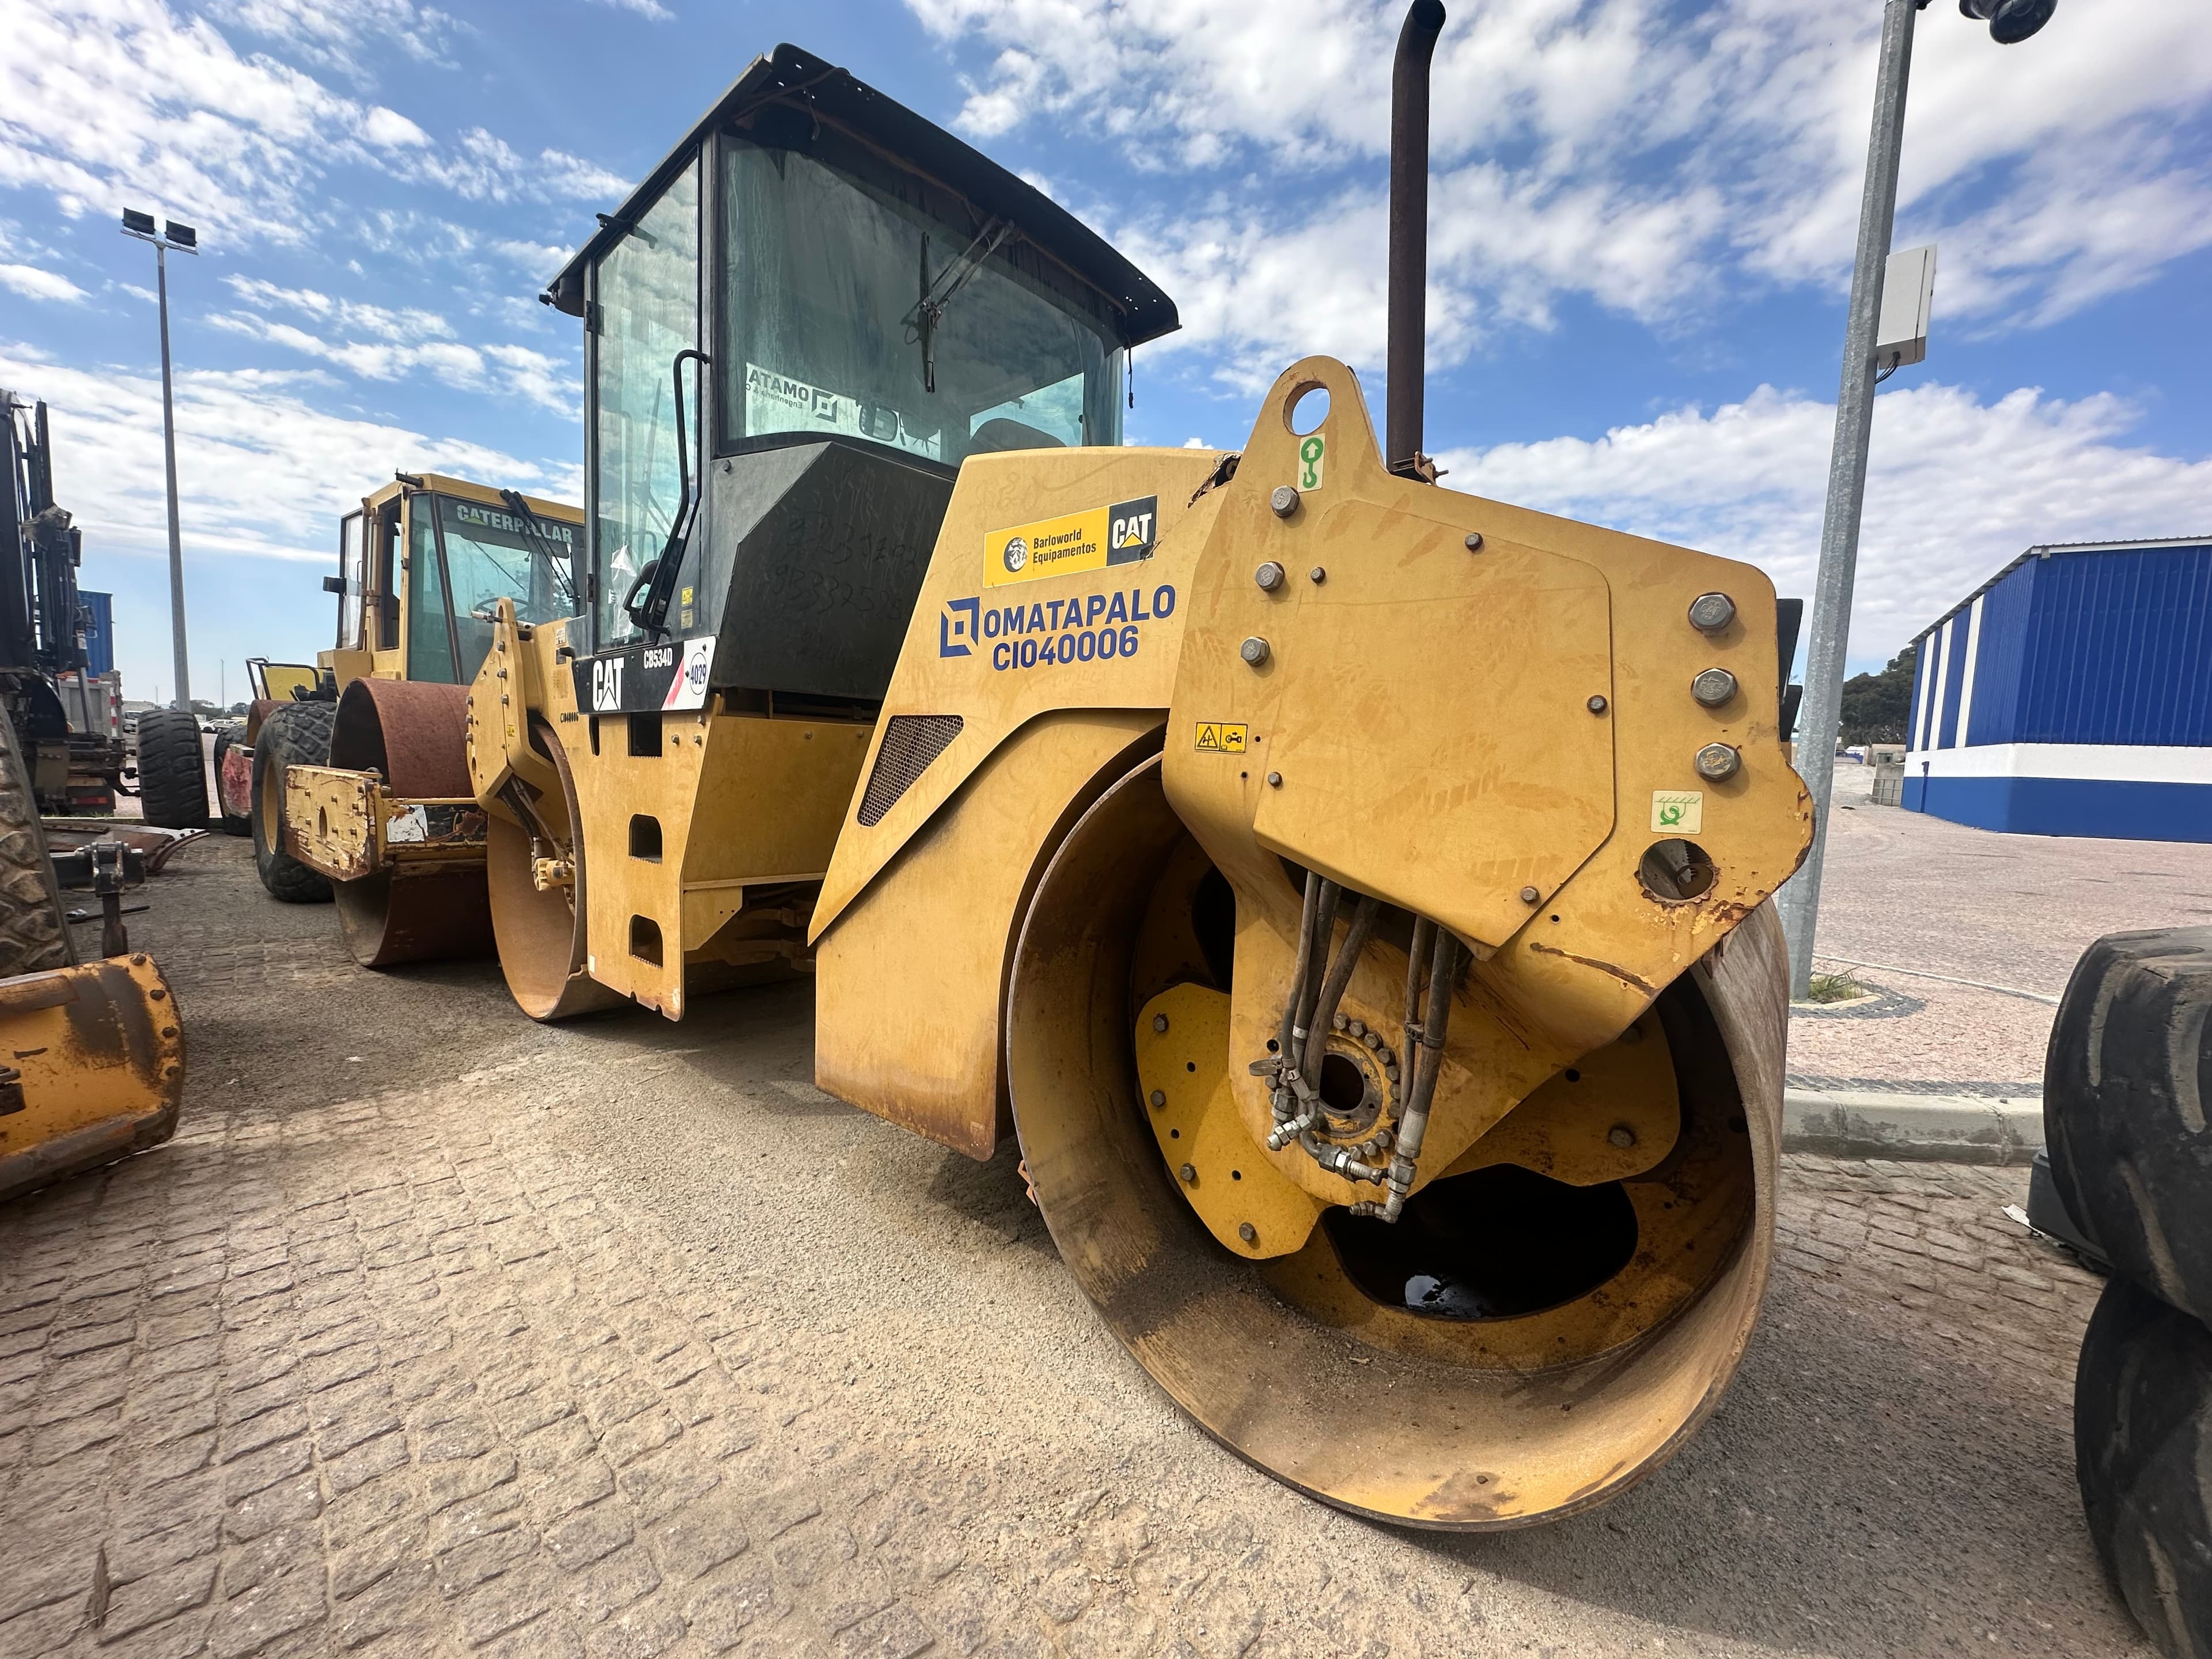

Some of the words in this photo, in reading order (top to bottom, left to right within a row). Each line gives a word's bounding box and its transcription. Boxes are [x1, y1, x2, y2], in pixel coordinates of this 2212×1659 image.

[1033, 529, 1082, 549] Barloworld
[1112, 513, 1152, 550] CAT
[1033, 543, 1097, 565] Equipamentos
[983, 584, 1176, 638] OMATAPALO
[643, 647, 673, 669] CB534D
[993, 626, 1139, 671] CI040006
[593, 657, 624, 711] CAT
[691, 664, 706, 685] 4029
